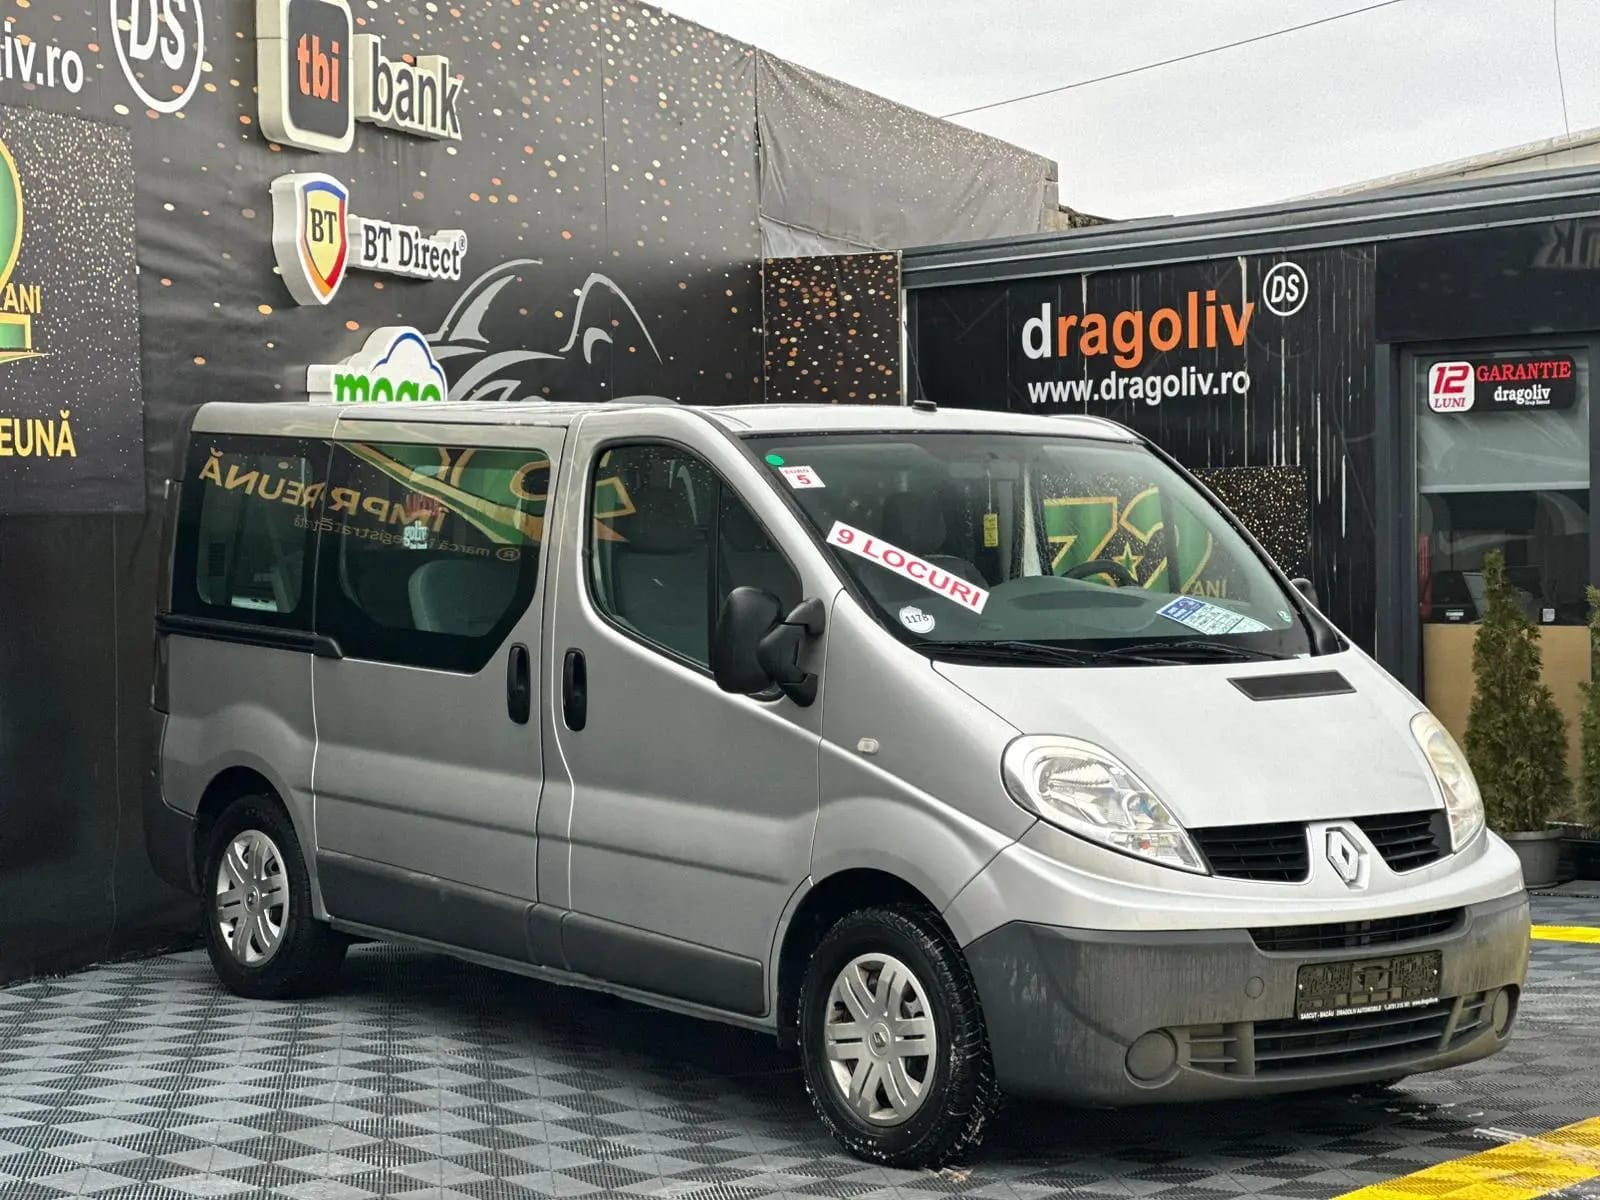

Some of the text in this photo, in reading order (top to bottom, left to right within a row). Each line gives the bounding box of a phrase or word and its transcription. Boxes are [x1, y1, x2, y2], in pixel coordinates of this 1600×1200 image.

[129, 0, 187, 70] DS
[0, 21, 84, 93] iv.ro
[297, 33, 463, 135] tbi bank
[310, 208, 337, 244] BT
[363, 224, 392, 263] BT
[3, 282, 41, 314] ANI
[1270, 273, 1301, 304] DS
[1022, 290, 1255, 368] dragoliv
[1027, 366, 1251, 406] www.dragoliv.ro
[1433, 365, 1470, 395] 12
[1476, 360, 1572, 382] GARANTIE
[1434, 397, 1466, 409] LUNI
[1494, 384, 1551, 405] dragoliv
[0, 409, 77, 458] EUNĂ
[796, 474, 812, 485] 5
[836, 528, 981, 607] 9 LOCURI
